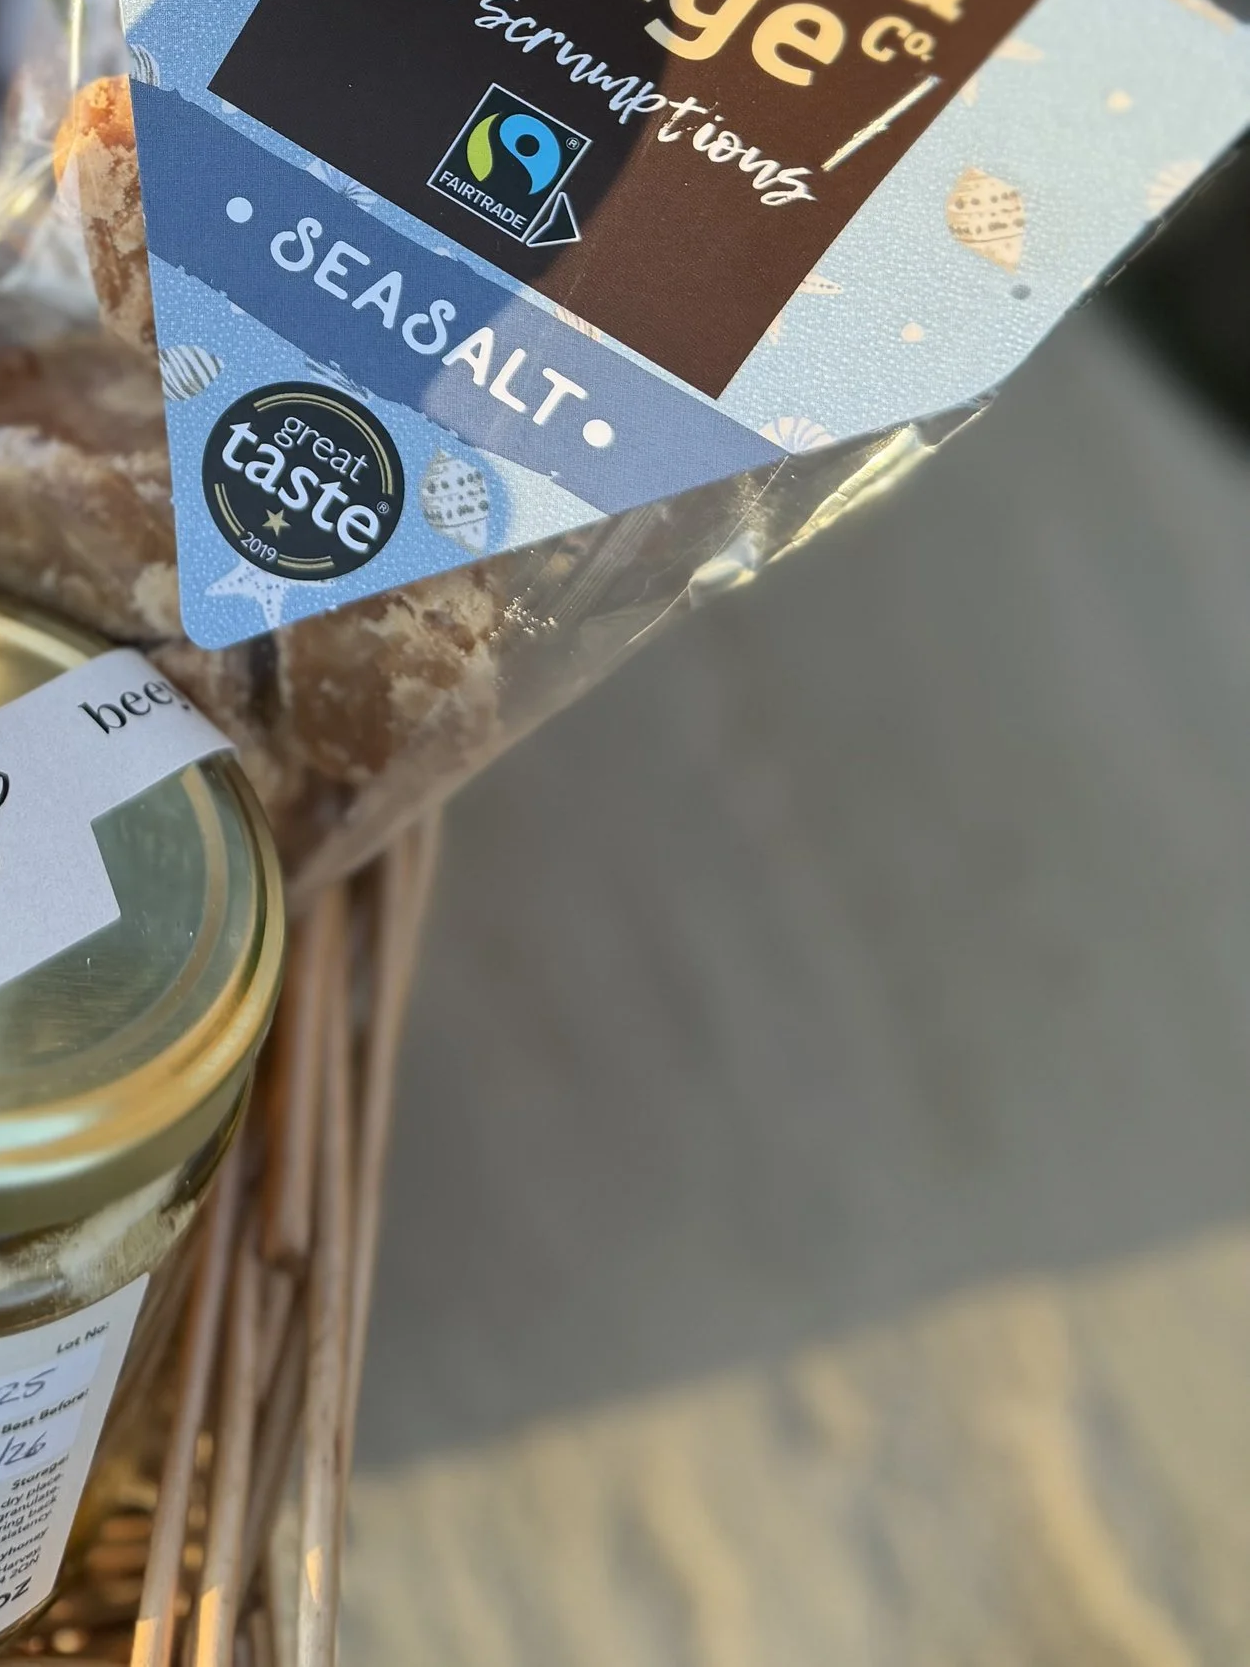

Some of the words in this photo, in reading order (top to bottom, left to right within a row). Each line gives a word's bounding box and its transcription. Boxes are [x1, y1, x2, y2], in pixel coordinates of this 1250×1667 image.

[438, 170, 528, 231] FAIRTRADE
[273, 415, 369, 484] great
[221, 421, 381, 554] taste
[240, 531, 278, 562] 2019
[56, 1336, 82, 1354] Lot
[0, 1416, 35, 1435] Best
[0, 1493, 25, 1509] dry
